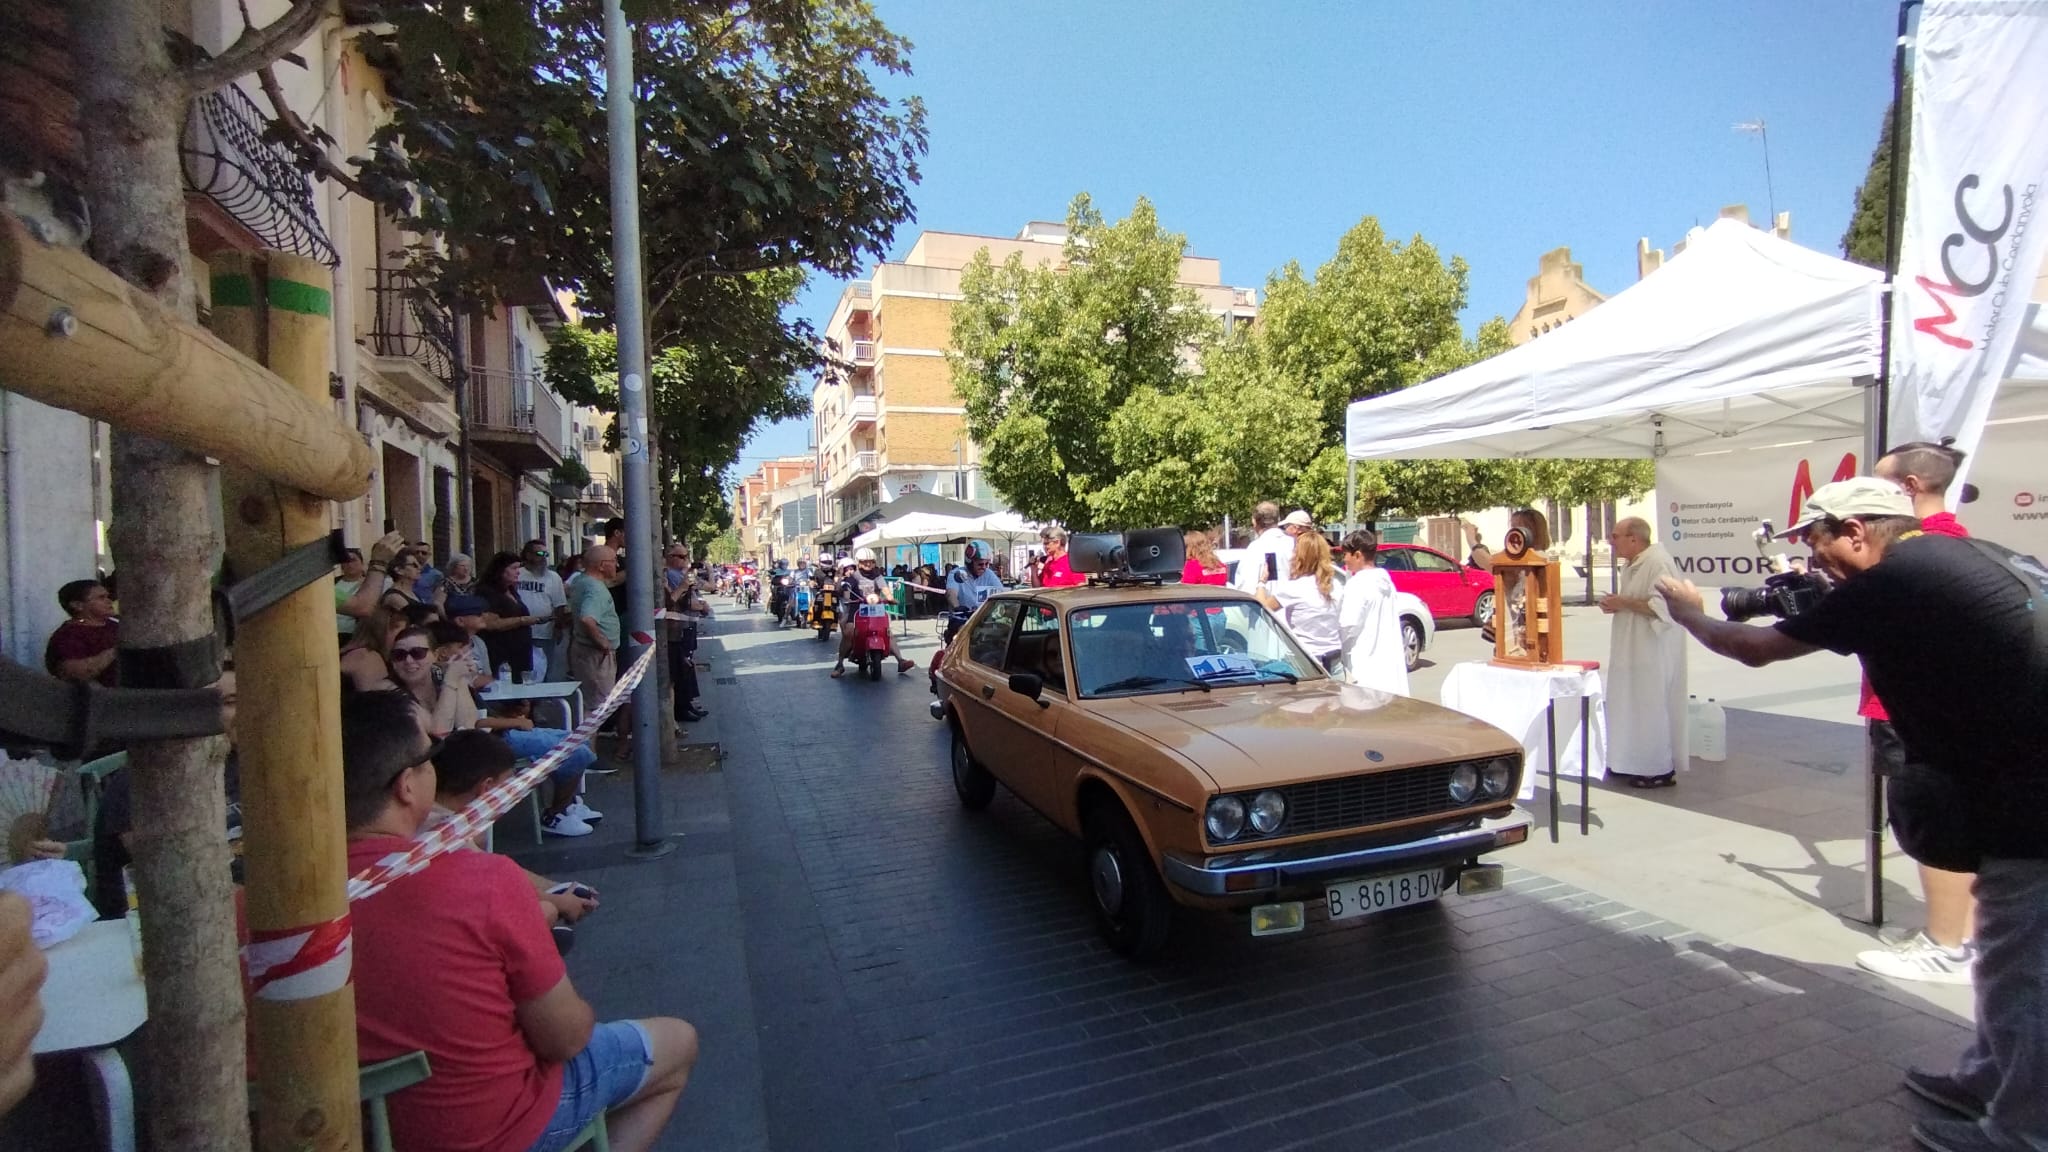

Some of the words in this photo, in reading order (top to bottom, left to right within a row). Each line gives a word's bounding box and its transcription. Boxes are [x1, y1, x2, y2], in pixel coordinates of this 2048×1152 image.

[1915, 173, 2014, 350] MCC
[1992, 273, 2010, 308] Club
[1718, 515, 1759, 525] Cerdanyola
[1674, 556, 1776, 574] MOTOR
